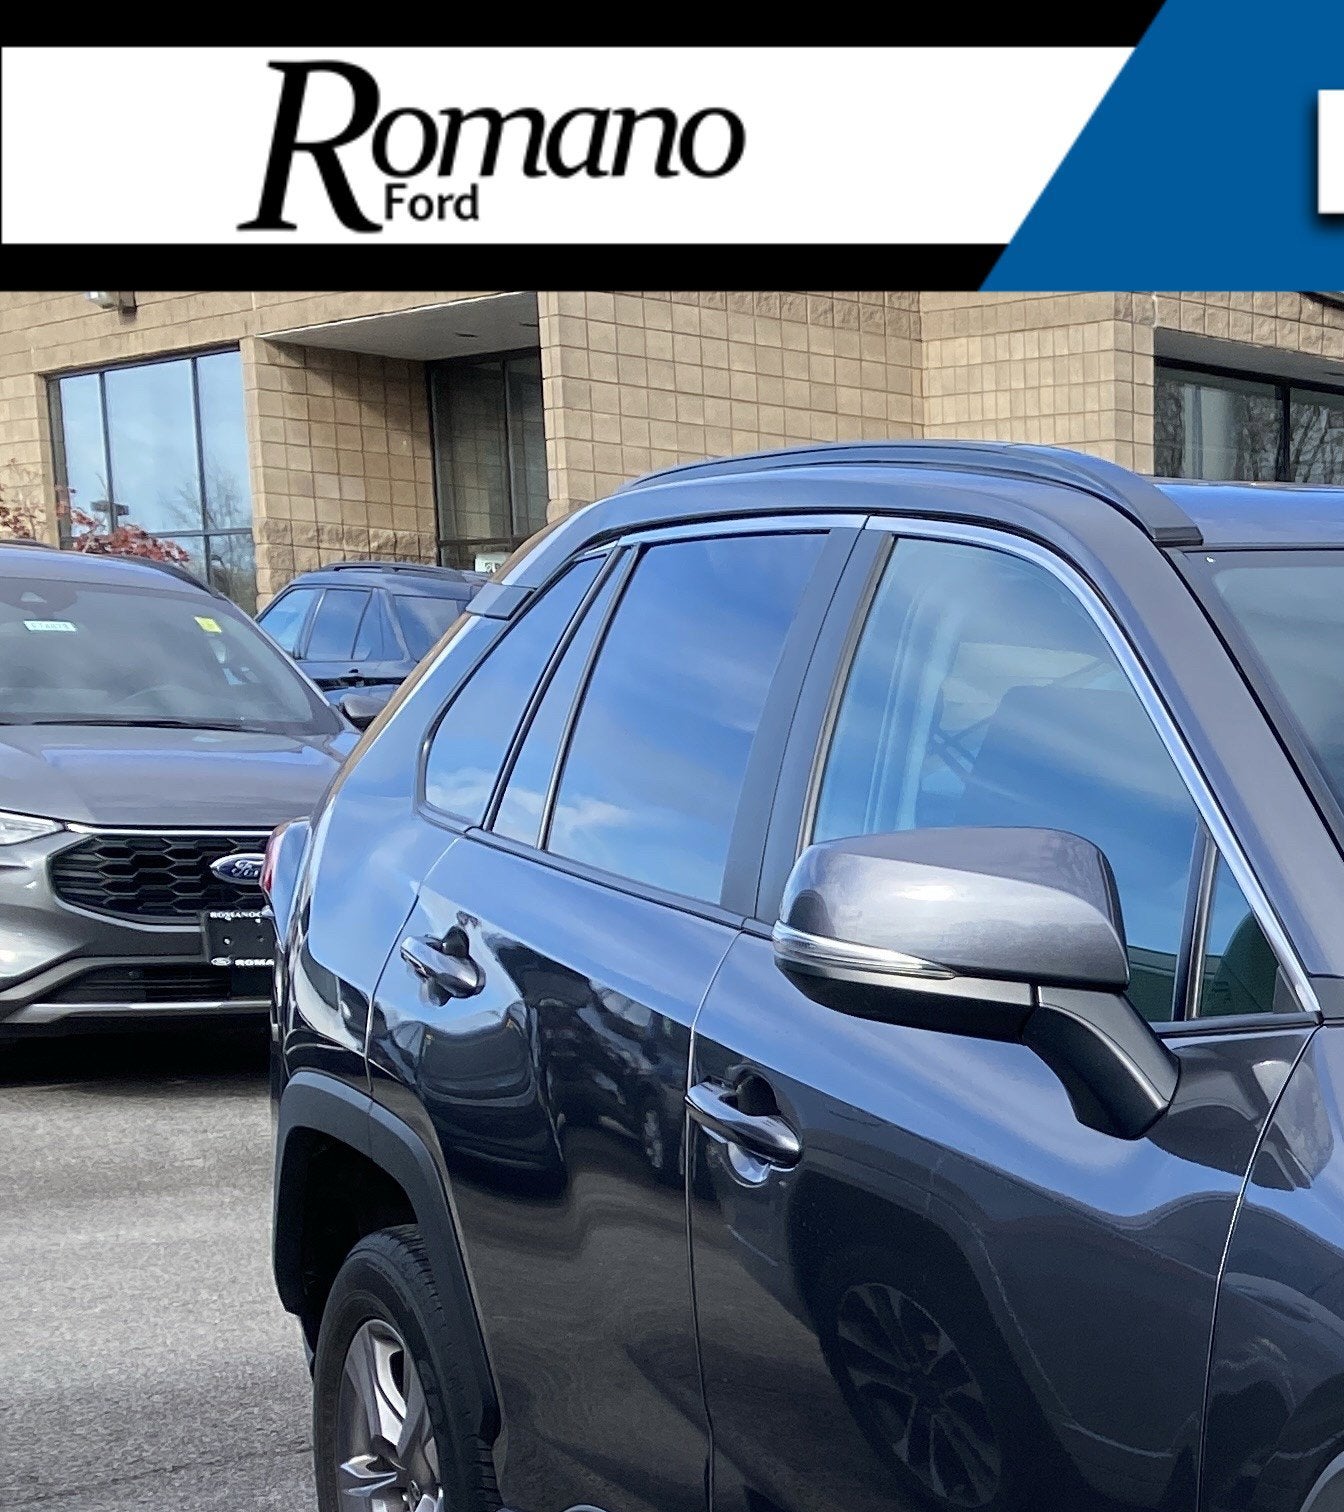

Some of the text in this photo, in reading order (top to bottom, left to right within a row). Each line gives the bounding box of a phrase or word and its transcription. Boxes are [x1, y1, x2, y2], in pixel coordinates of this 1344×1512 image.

[231, 860, 263, 878] For
[209, 911, 263, 919] ROMANOC
[234, 958, 275, 967] ROMA
